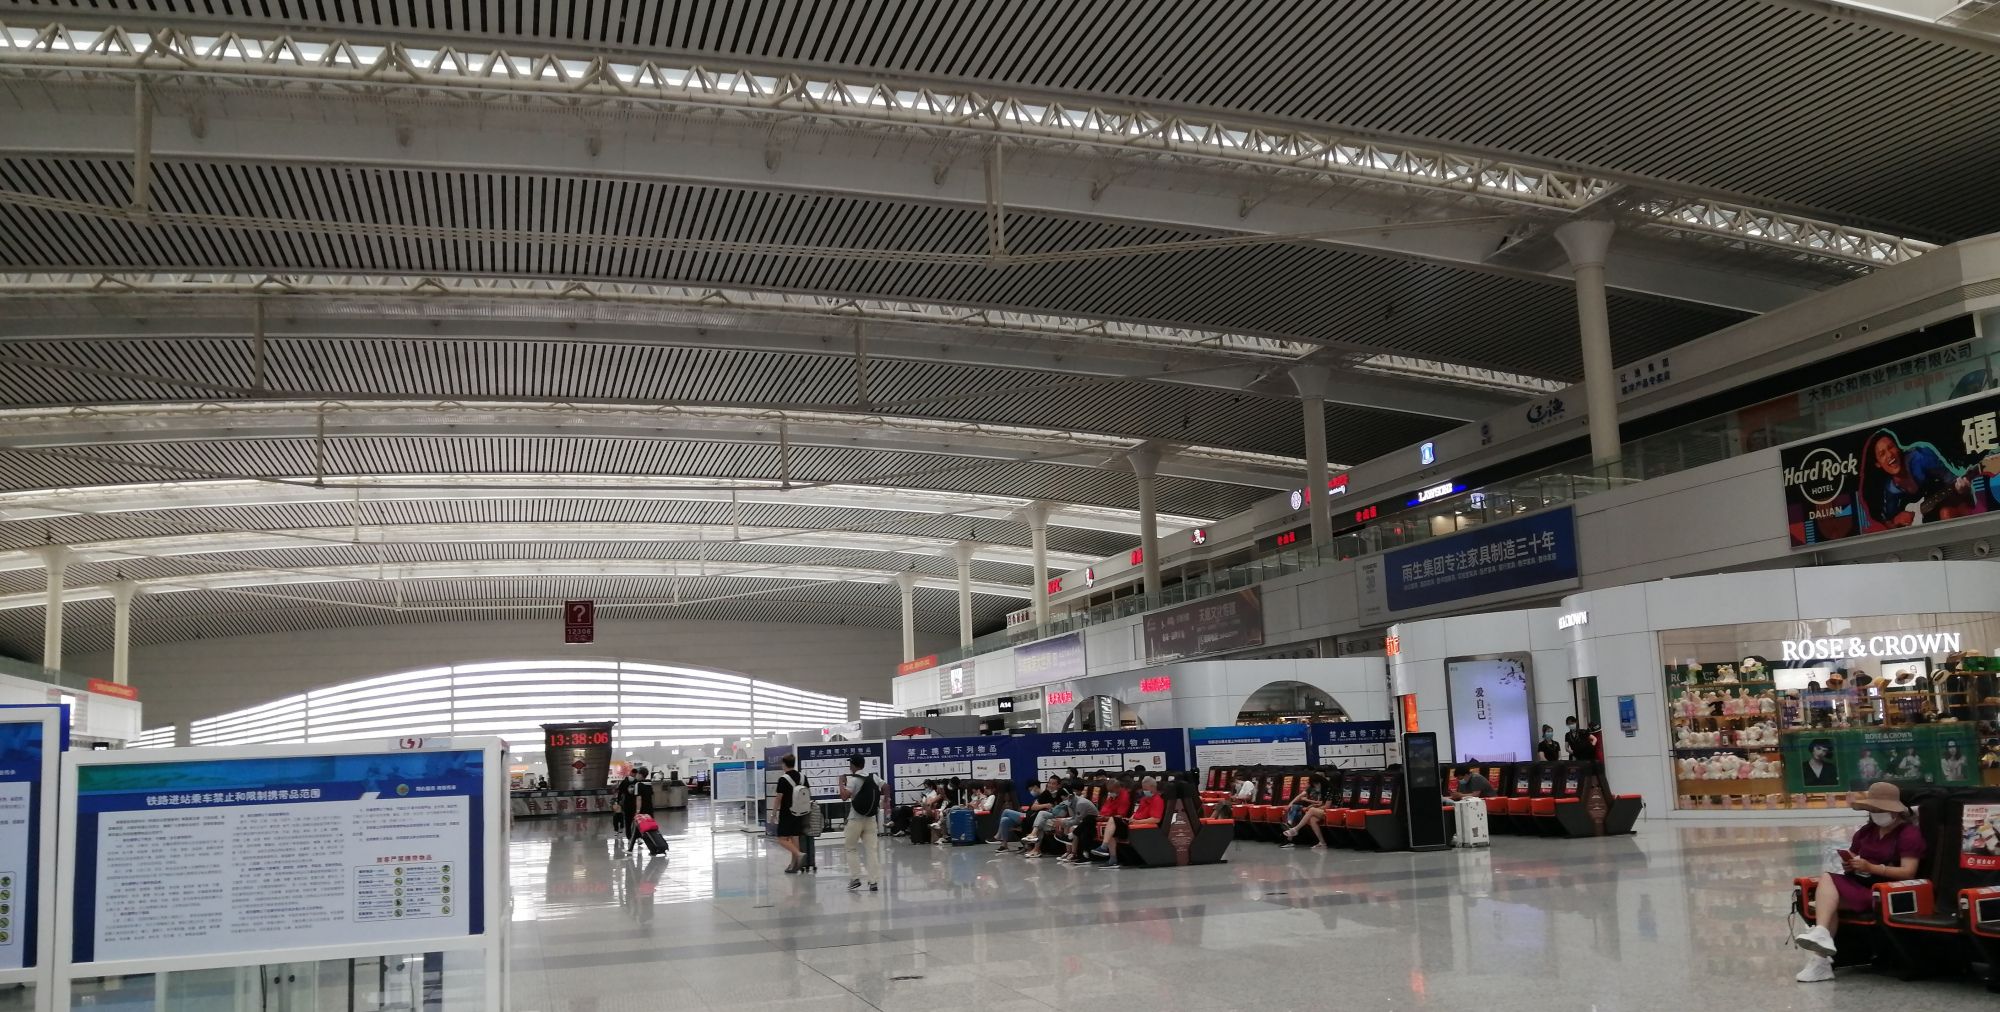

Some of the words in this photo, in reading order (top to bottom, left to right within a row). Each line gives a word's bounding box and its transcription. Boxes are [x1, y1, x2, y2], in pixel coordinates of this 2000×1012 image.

[1962, 412, 1998, 455] 硬
[1784, 461, 1820, 487] Hard
[1821, 453, 1859, 481] Rock
[1811, 484, 1835, 495] HOTEL
[1809, 506, 1843, 520] DALIAN
[1401, 531, 1556, 582] 雨生集团专注家具制造三十年
[1782, 638, 1844, 661] ROSE
[1848, 637, 1868, 657] &
[1869, 632, 1961, 656] CROWN
[1475, 687, 1486, 720] 爱自己
[550, 732, 609, 746] 13:38:06
[1051, 738, 1151, 749] 禁止携带下列物品
[907, 745, 997, 756] 禁止携带下列物品
[146, 788, 321, 806] 铁路进站乘车禁止和限制携带品范围
